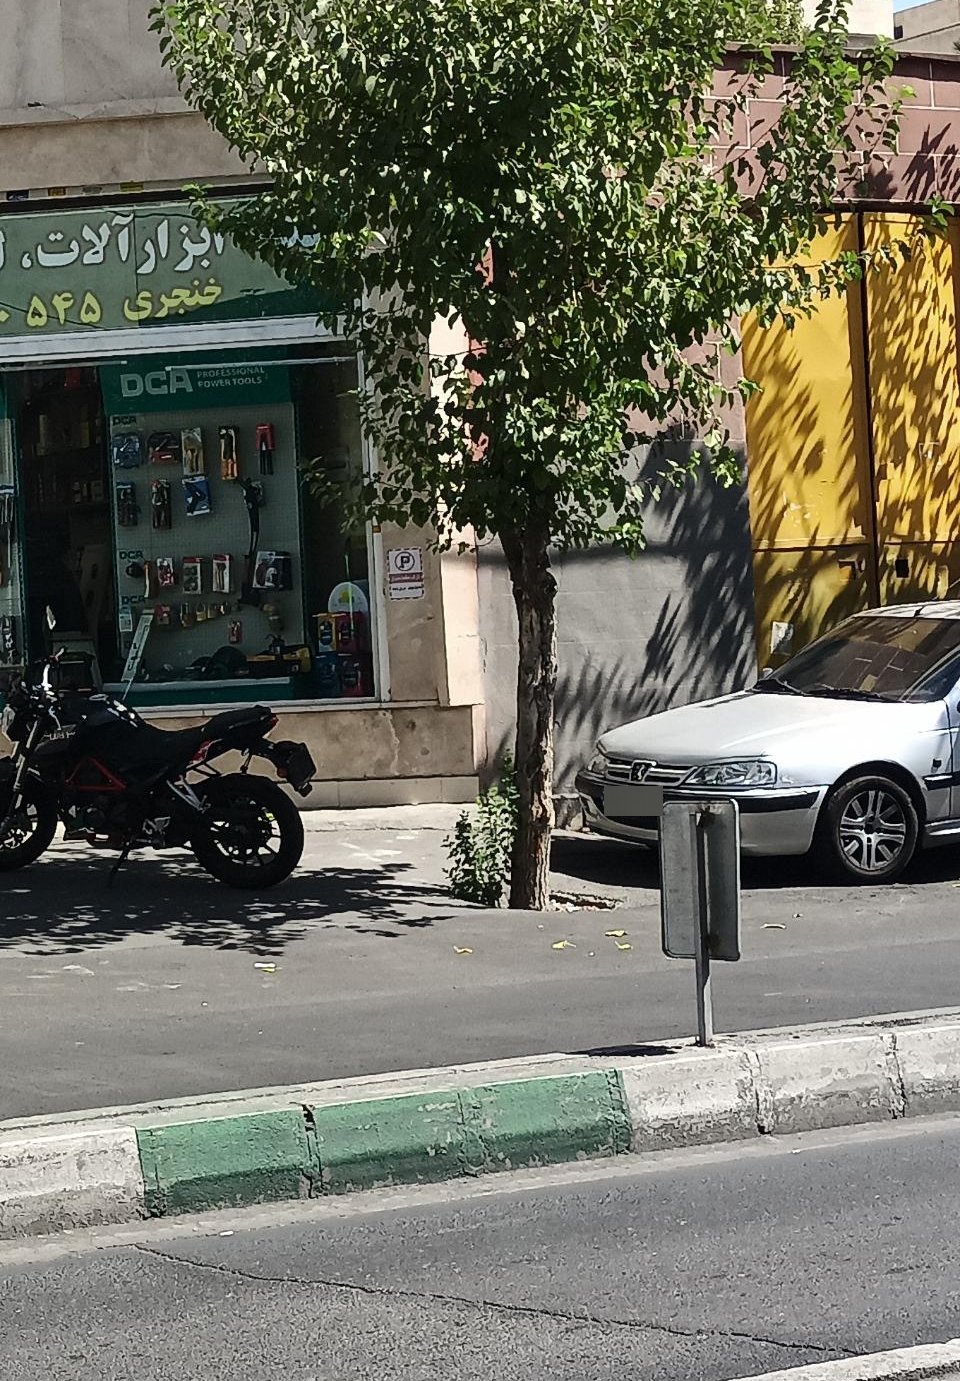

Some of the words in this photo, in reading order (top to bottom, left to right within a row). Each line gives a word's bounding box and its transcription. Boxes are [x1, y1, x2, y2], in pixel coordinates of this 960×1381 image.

[26, 291, 101, 327] ۵۴۵
[123, 277, 222, 321] خنجری
[120, 368, 194, 398] DCA
[196, 365, 266, 379] PROFESSIONAL
[198, 378, 231, 389] POWER
[233, 375, 263, 386] TOOLS
